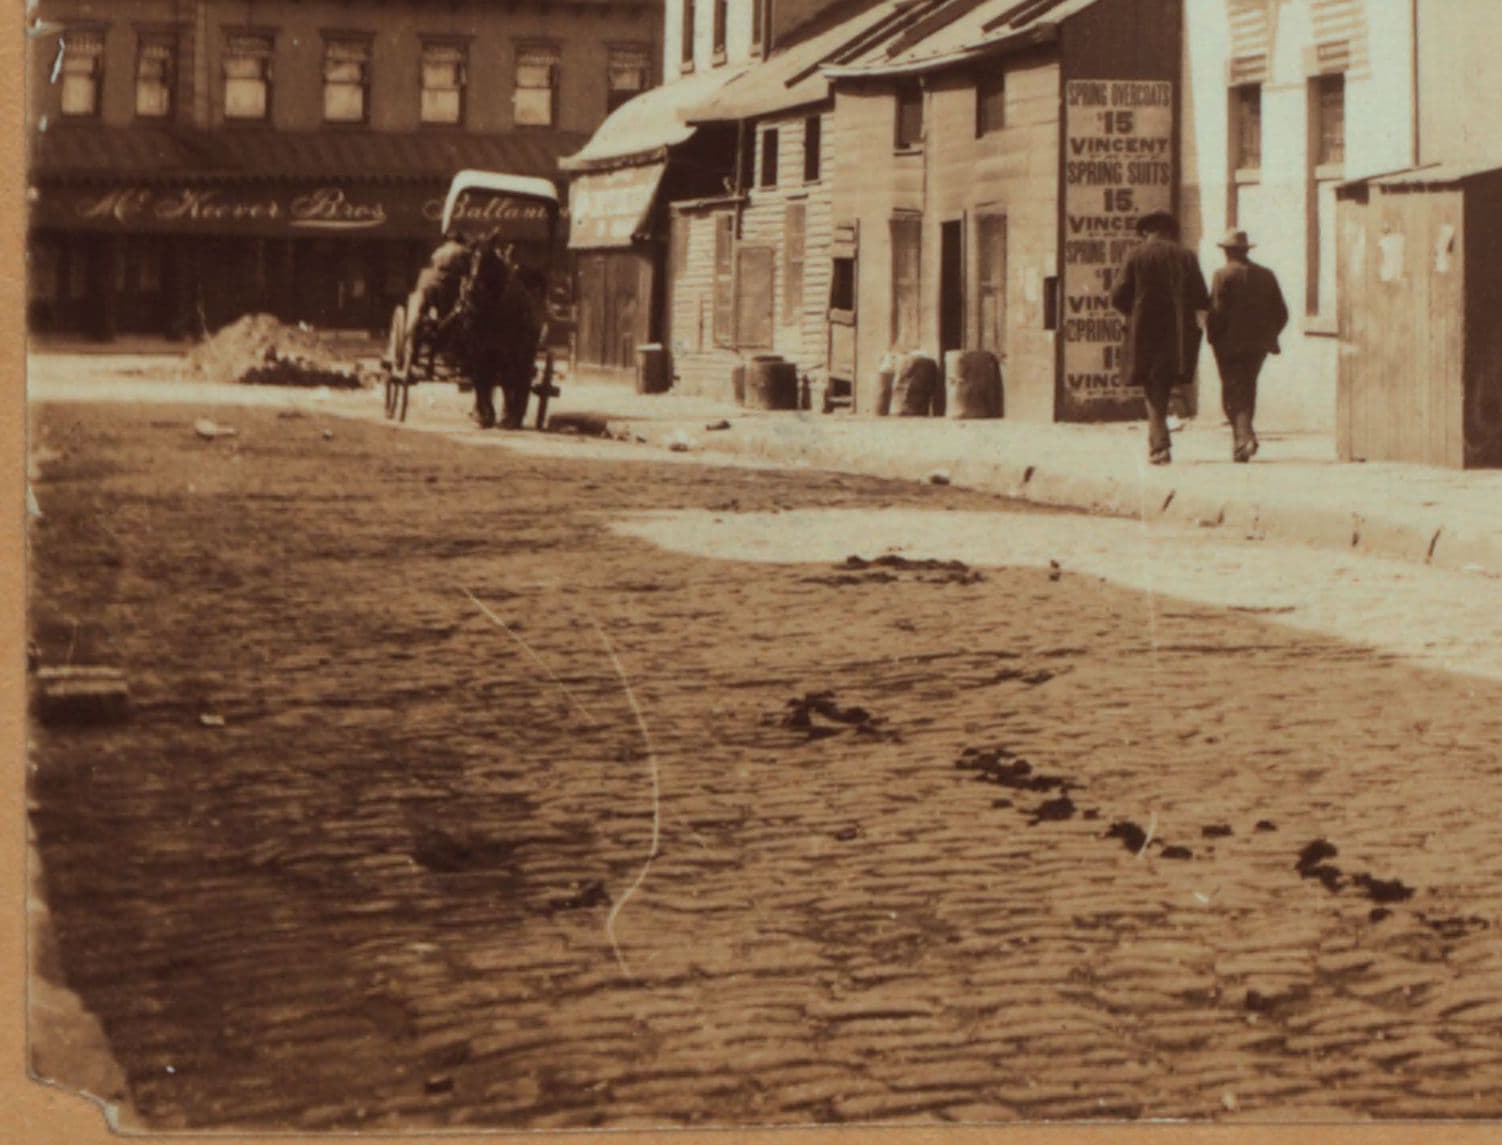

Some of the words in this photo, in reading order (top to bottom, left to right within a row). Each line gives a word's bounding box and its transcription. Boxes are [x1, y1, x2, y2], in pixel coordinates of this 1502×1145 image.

[1069, 137, 1169, 155] VINCENT
[1067, 161, 1123, 185] SPRING
[1127, 161, 1172, 186] SUITS
